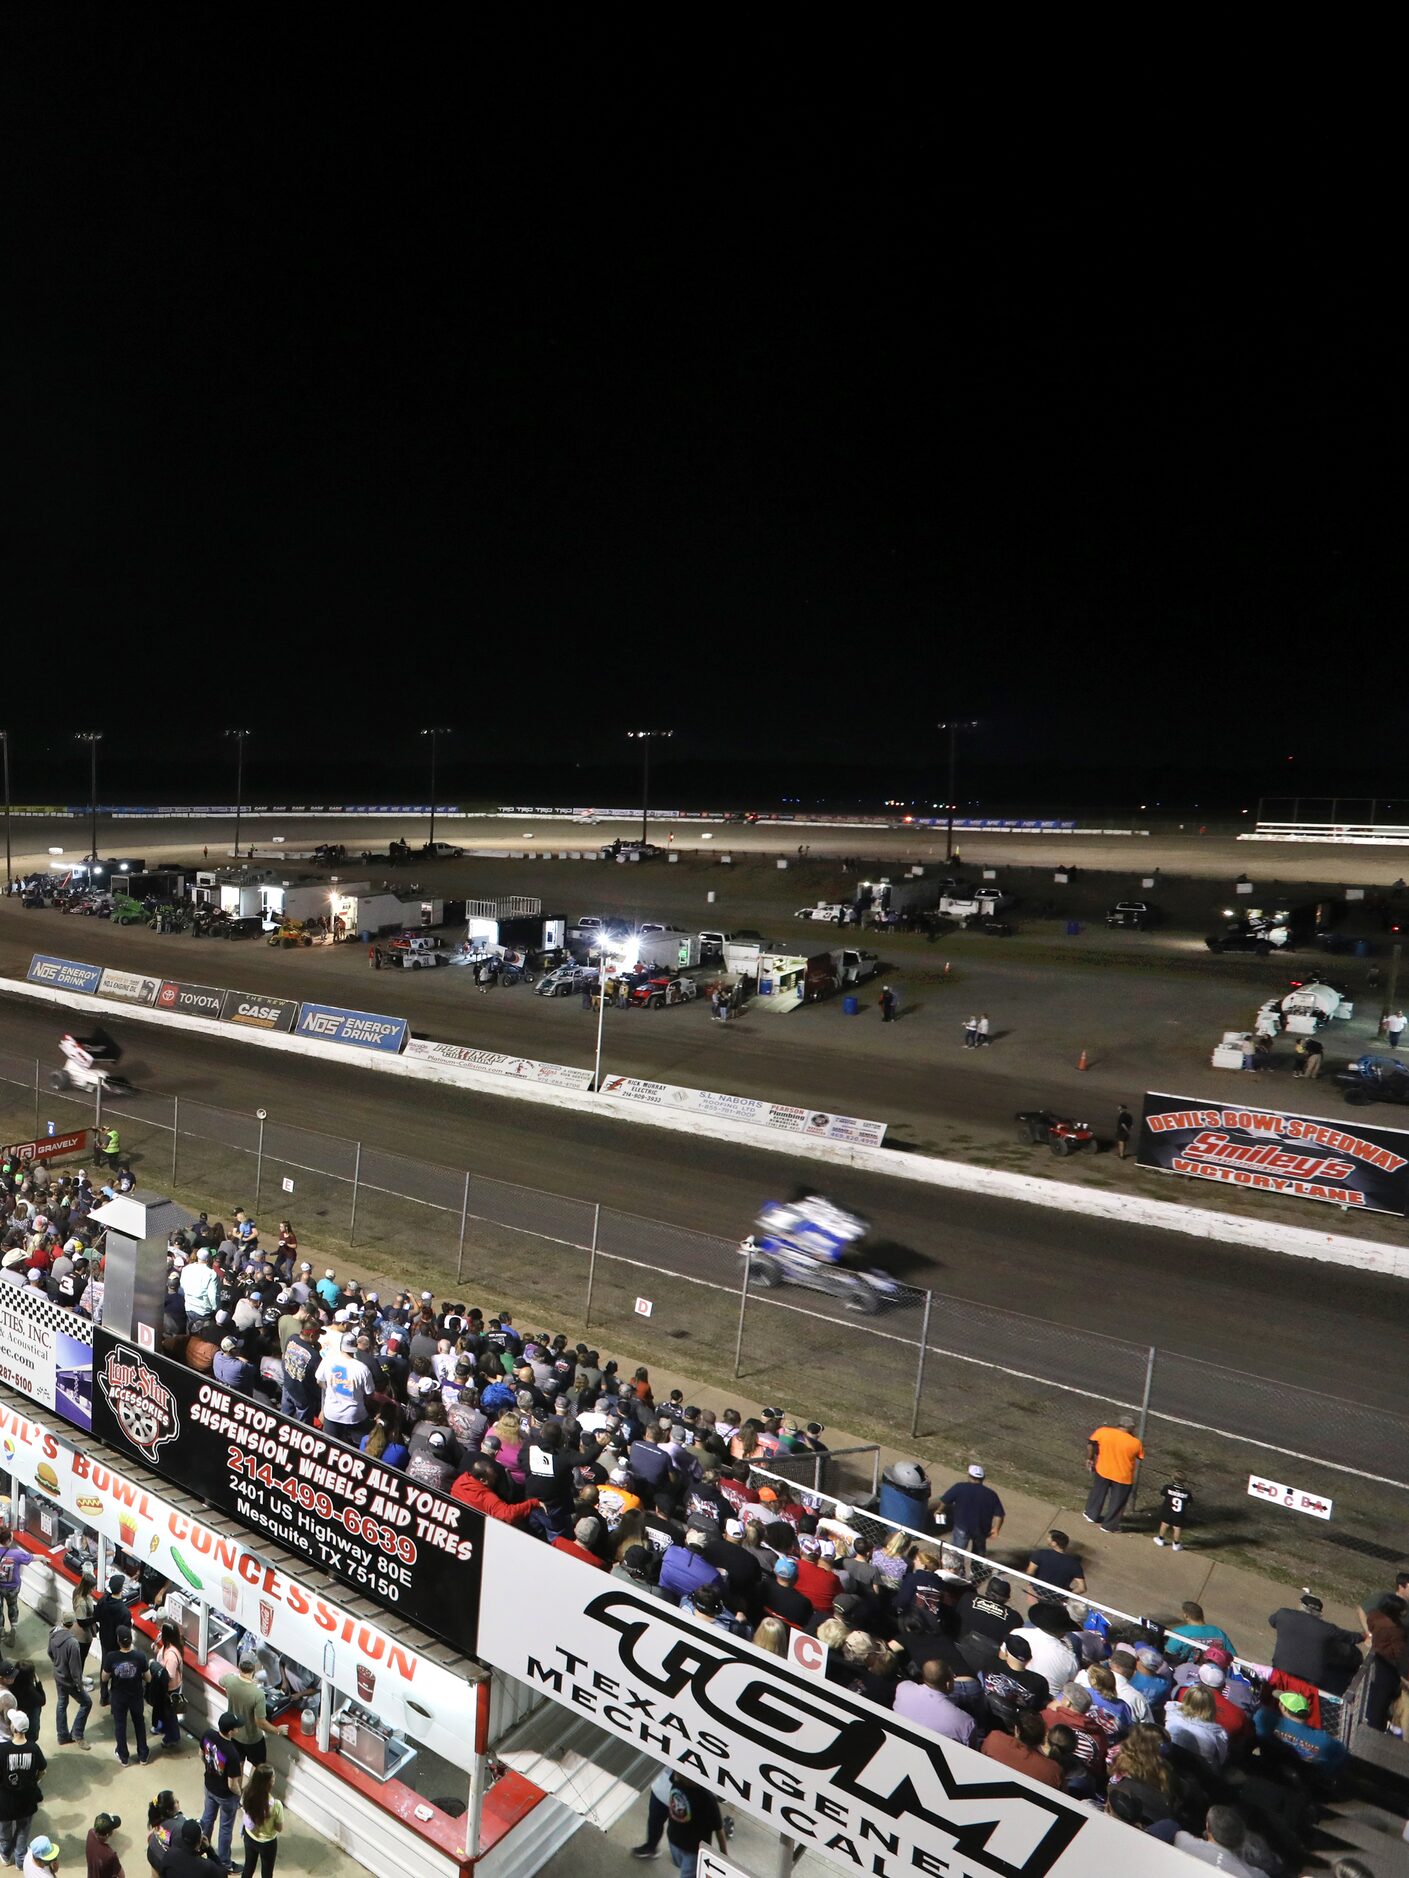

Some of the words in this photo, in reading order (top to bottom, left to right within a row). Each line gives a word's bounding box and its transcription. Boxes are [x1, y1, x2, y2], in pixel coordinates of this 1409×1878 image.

[32, 961, 62, 980] NOS
[58, 973, 86, 987] DRINK
[61, 966, 97, 980] ENERGY
[179, 992, 220, 1010] TOYOTA
[237, 1003, 282, 1021] CASE
[302, 1012, 346, 1035] NOS
[345, 1018, 401, 1036] ENERGY
[341, 1028, 384, 1044] DRINK
[433, 1044, 509, 1064] PLATINUM
[427, 1055, 504, 1074] Platinum-Collision.com
[631, 1086, 658, 1096] ELECTRIC
[643, 1081, 667, 1091] MURRAY
[699, 1091, 716, 1100] S.L.
[718, 1094, 764, 1109] NABORS
[702, 1099, 738, 1109] ROOFING
[741, 1105, 756, 1113] LTD
[768, 1109, 805, 1121] Plumbing
[771, 1105, 805, 1115] PEARSON
[37, 1138, 79, 1154] GRAVELY
[1146, 1110, 1222, 1133] DEVIL'S
[1221, 1110, 1286, 1135] BOWL
[1288, 1120, 1409, 1173] SPEEDWAY
[1180, 1131, 1356, 1180] Smiley's
[284, 1180, 292, 1191] E
[1172, 1157, 1288, 1191] VICTORY
[1293, 1180, 1366, 1206] LANE
[59, 1275, 75, 1296] 3
[638, 1299, 648, 1313] D
[28, 1323, 52, 1349] INC.
[142, 1328, 153, 1346] D
[7, 1332, 48, 1361] Acoustical
[108, 1354, 138, 1390] Lone
[136, 1364, 171, 1412] Star
[108, 1386, 169, 1427] ACCESSORIES
[198, 1384, 232, 1414] ONE
[233, 1402, 277, 1434] STOP
[278, 1423, 327, 1459] SHOP
[327, 1447, 365, 1480] FOR
[366, 1467, 400, 1498] ALL
[406, 1485, 462, 1529] YOUR
[190, 1404, 293, 1473] SUSPENSION,
[298, 1456, 368, 1506] WHEELS
[369, 1497, 412, 1527] AND
[415, 1517, 473, 1562] TIRES
[1269, 1486, 1278, 1498] D
[226, 1446, 417, 1566] 214-499-6639
[1171, 1497, 1182, 1513] 9
[1283, 1496, 1294, 1509] C
[229, 1475, 265, 1501] 2401
[269, 1497, 294, 1521] US
[297, 1511, 373, 1566] Highway
[377, 1556, 413, 1589] 80E
[237, 1498, 314, 1556] Mesquite,
[318, 1542, 343, 1571] TX
[347, 1558, 400, 1602] 75150
[71, 1449, 154, 1522] BOWL
[167, 1510, 418, 1682] CONCESSION
[793, 1635, 823, 1671] C
[583, 1590, 1088, 1878] TGM
[527, 1655, 897, 1878] MECHANICAL
[555, 1645, 731, 1760] TEXAS
[758, 1763, 974, 1878] GENE
